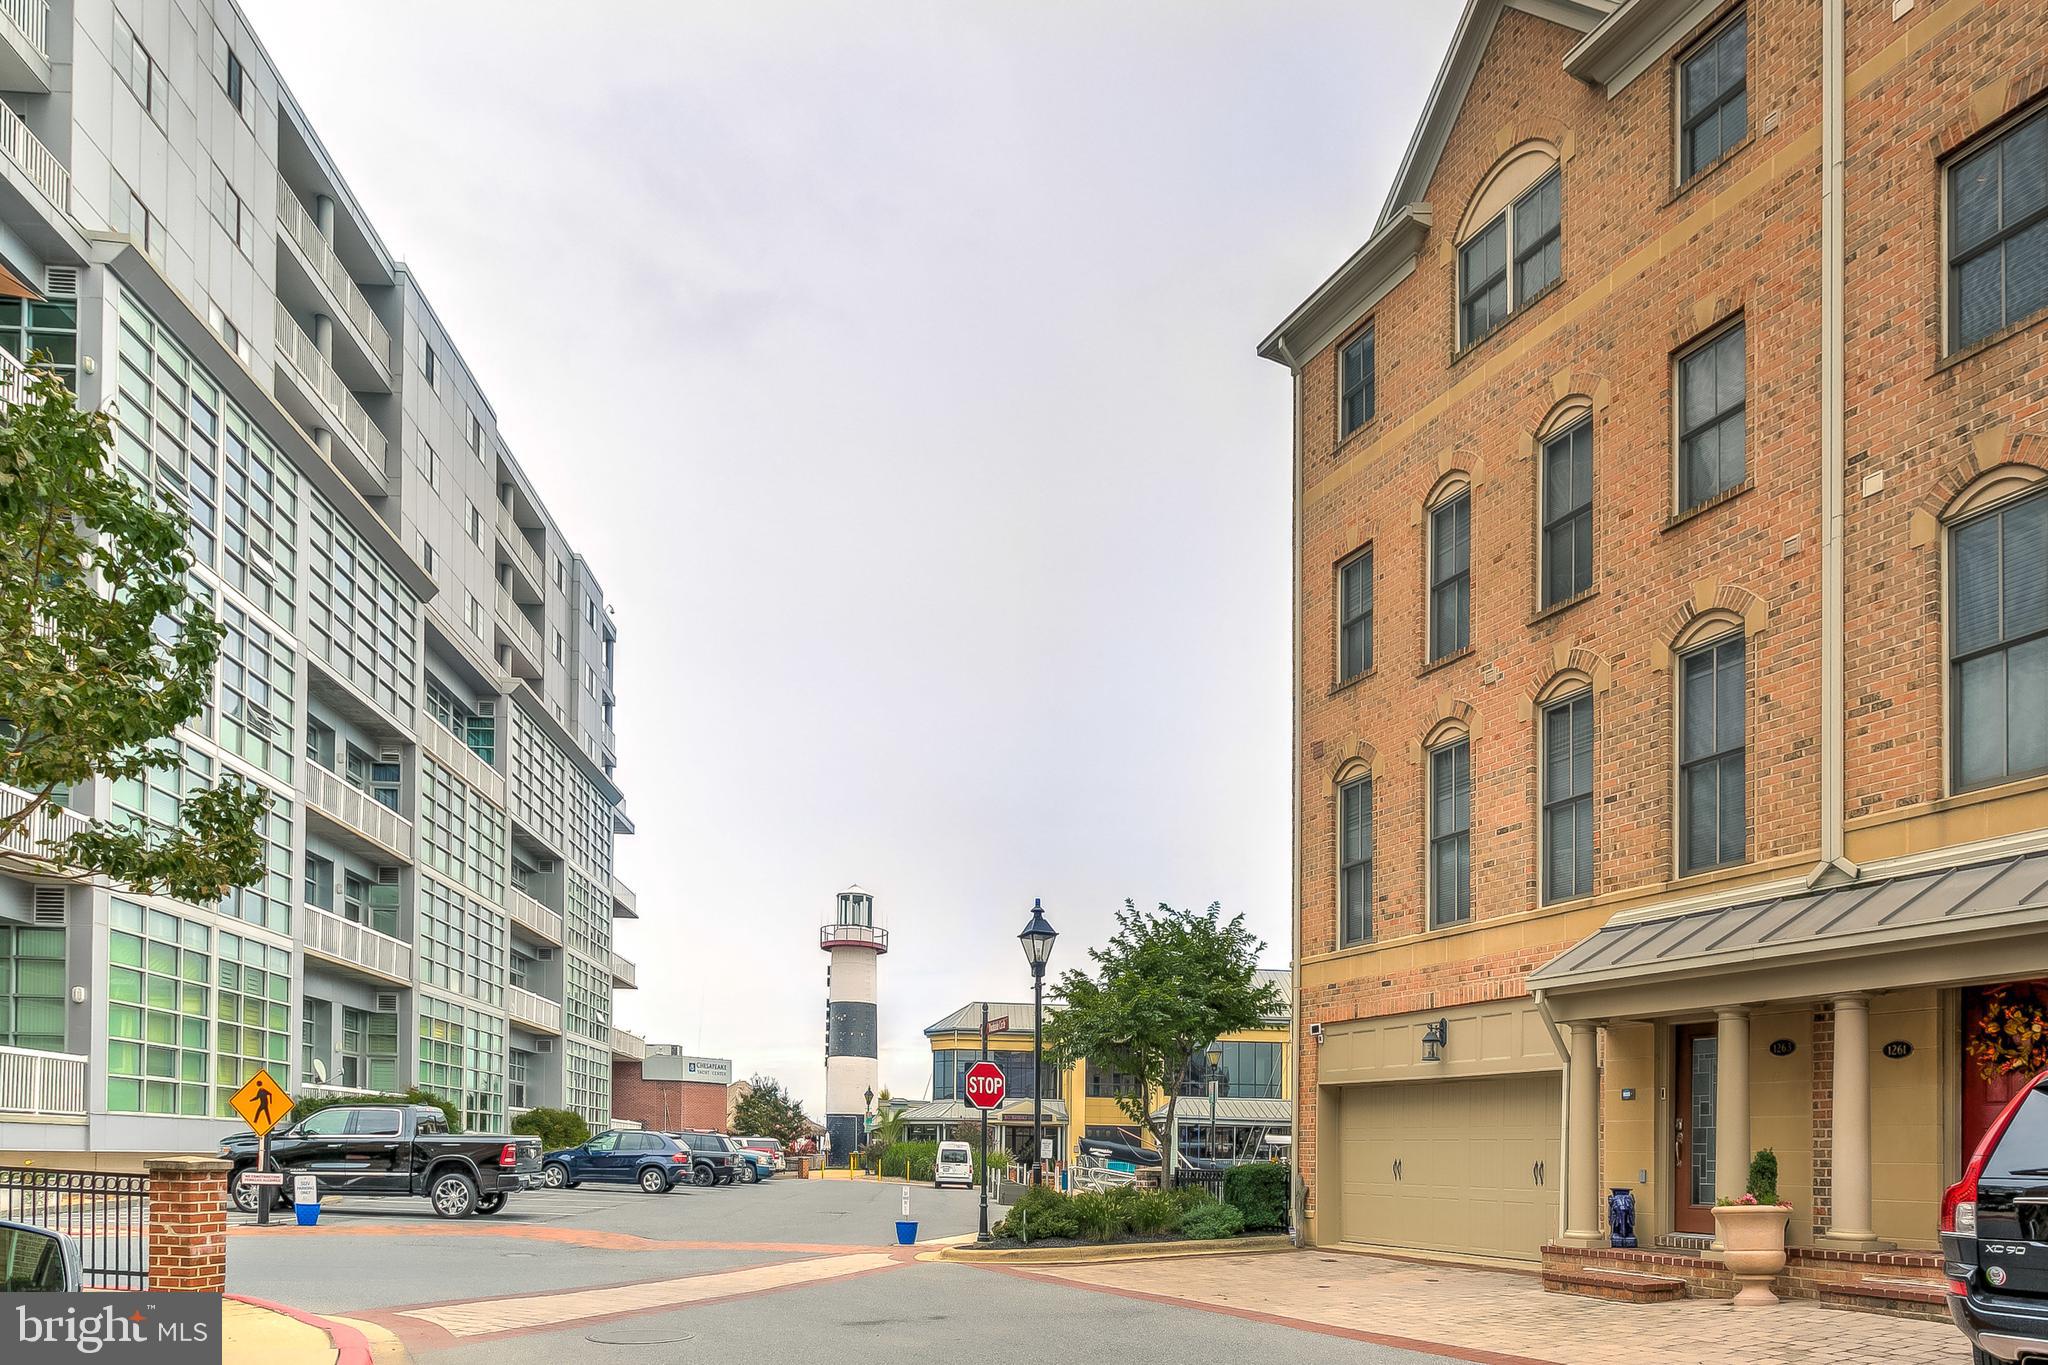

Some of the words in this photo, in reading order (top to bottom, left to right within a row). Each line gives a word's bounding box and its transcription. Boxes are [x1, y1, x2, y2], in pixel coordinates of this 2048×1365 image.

[1773, 1042, 1792, 1054] 1263
[1887, 1044, 1907, 1056] 1261
[696, 1062, 727, 1070] CHESAPEAKE
[969, 1076, 1003, 1095] STOP
